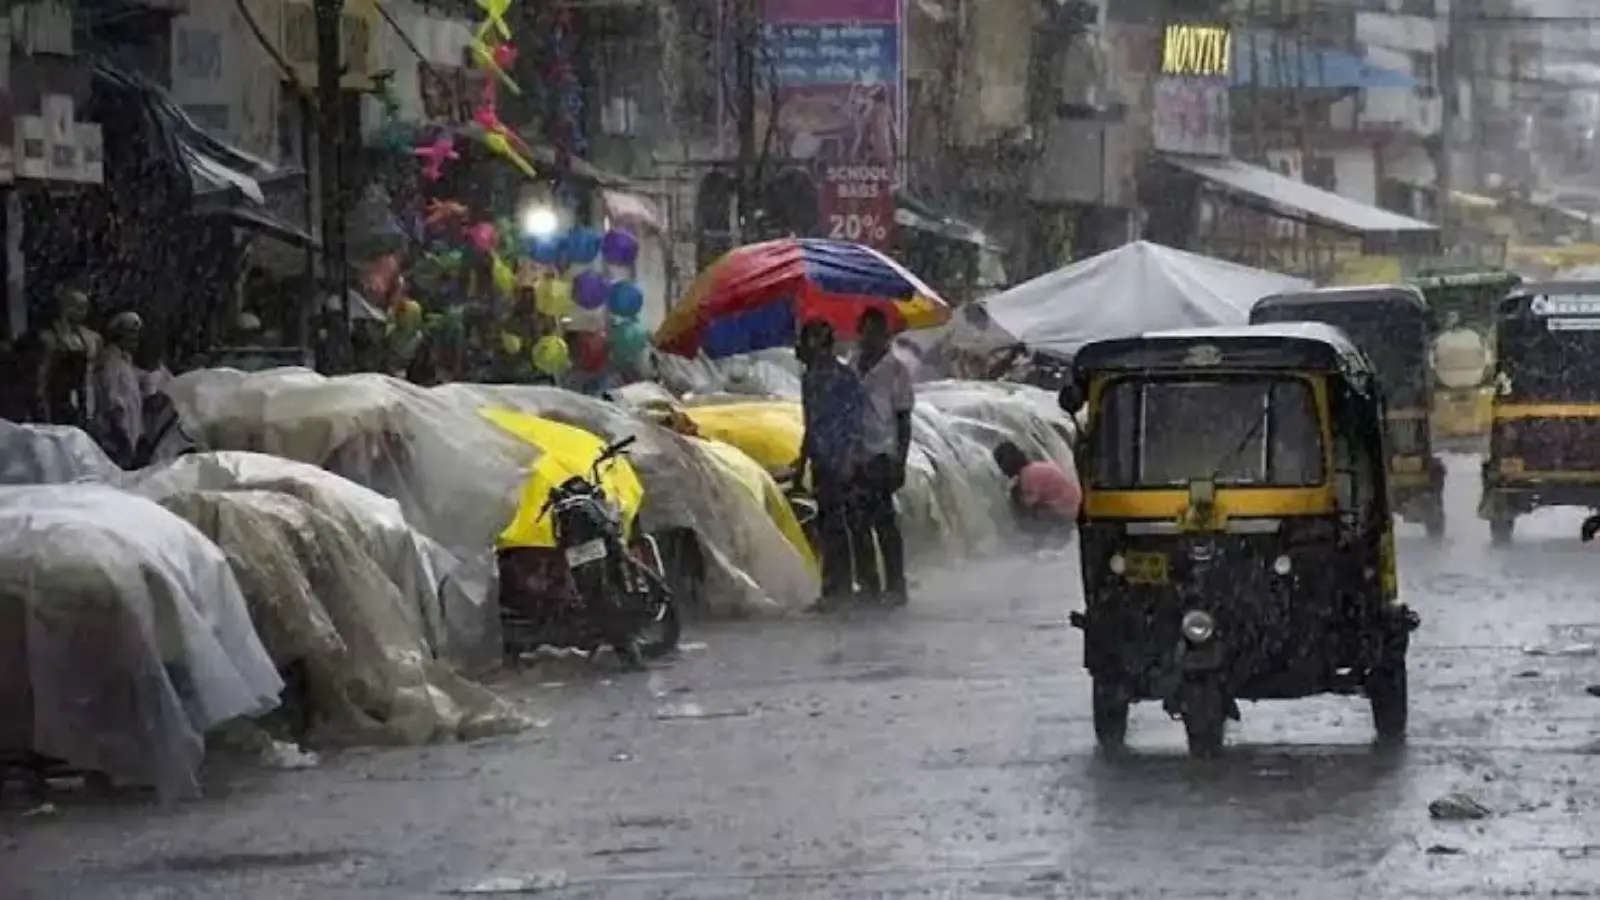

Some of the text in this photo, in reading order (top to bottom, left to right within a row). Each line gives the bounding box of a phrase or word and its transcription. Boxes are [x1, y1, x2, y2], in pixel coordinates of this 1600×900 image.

[826, 166, 889, 181] SCHOOL
[838, 184, 878, 198] BAGS
[829, 213, 887, 241] 20%
